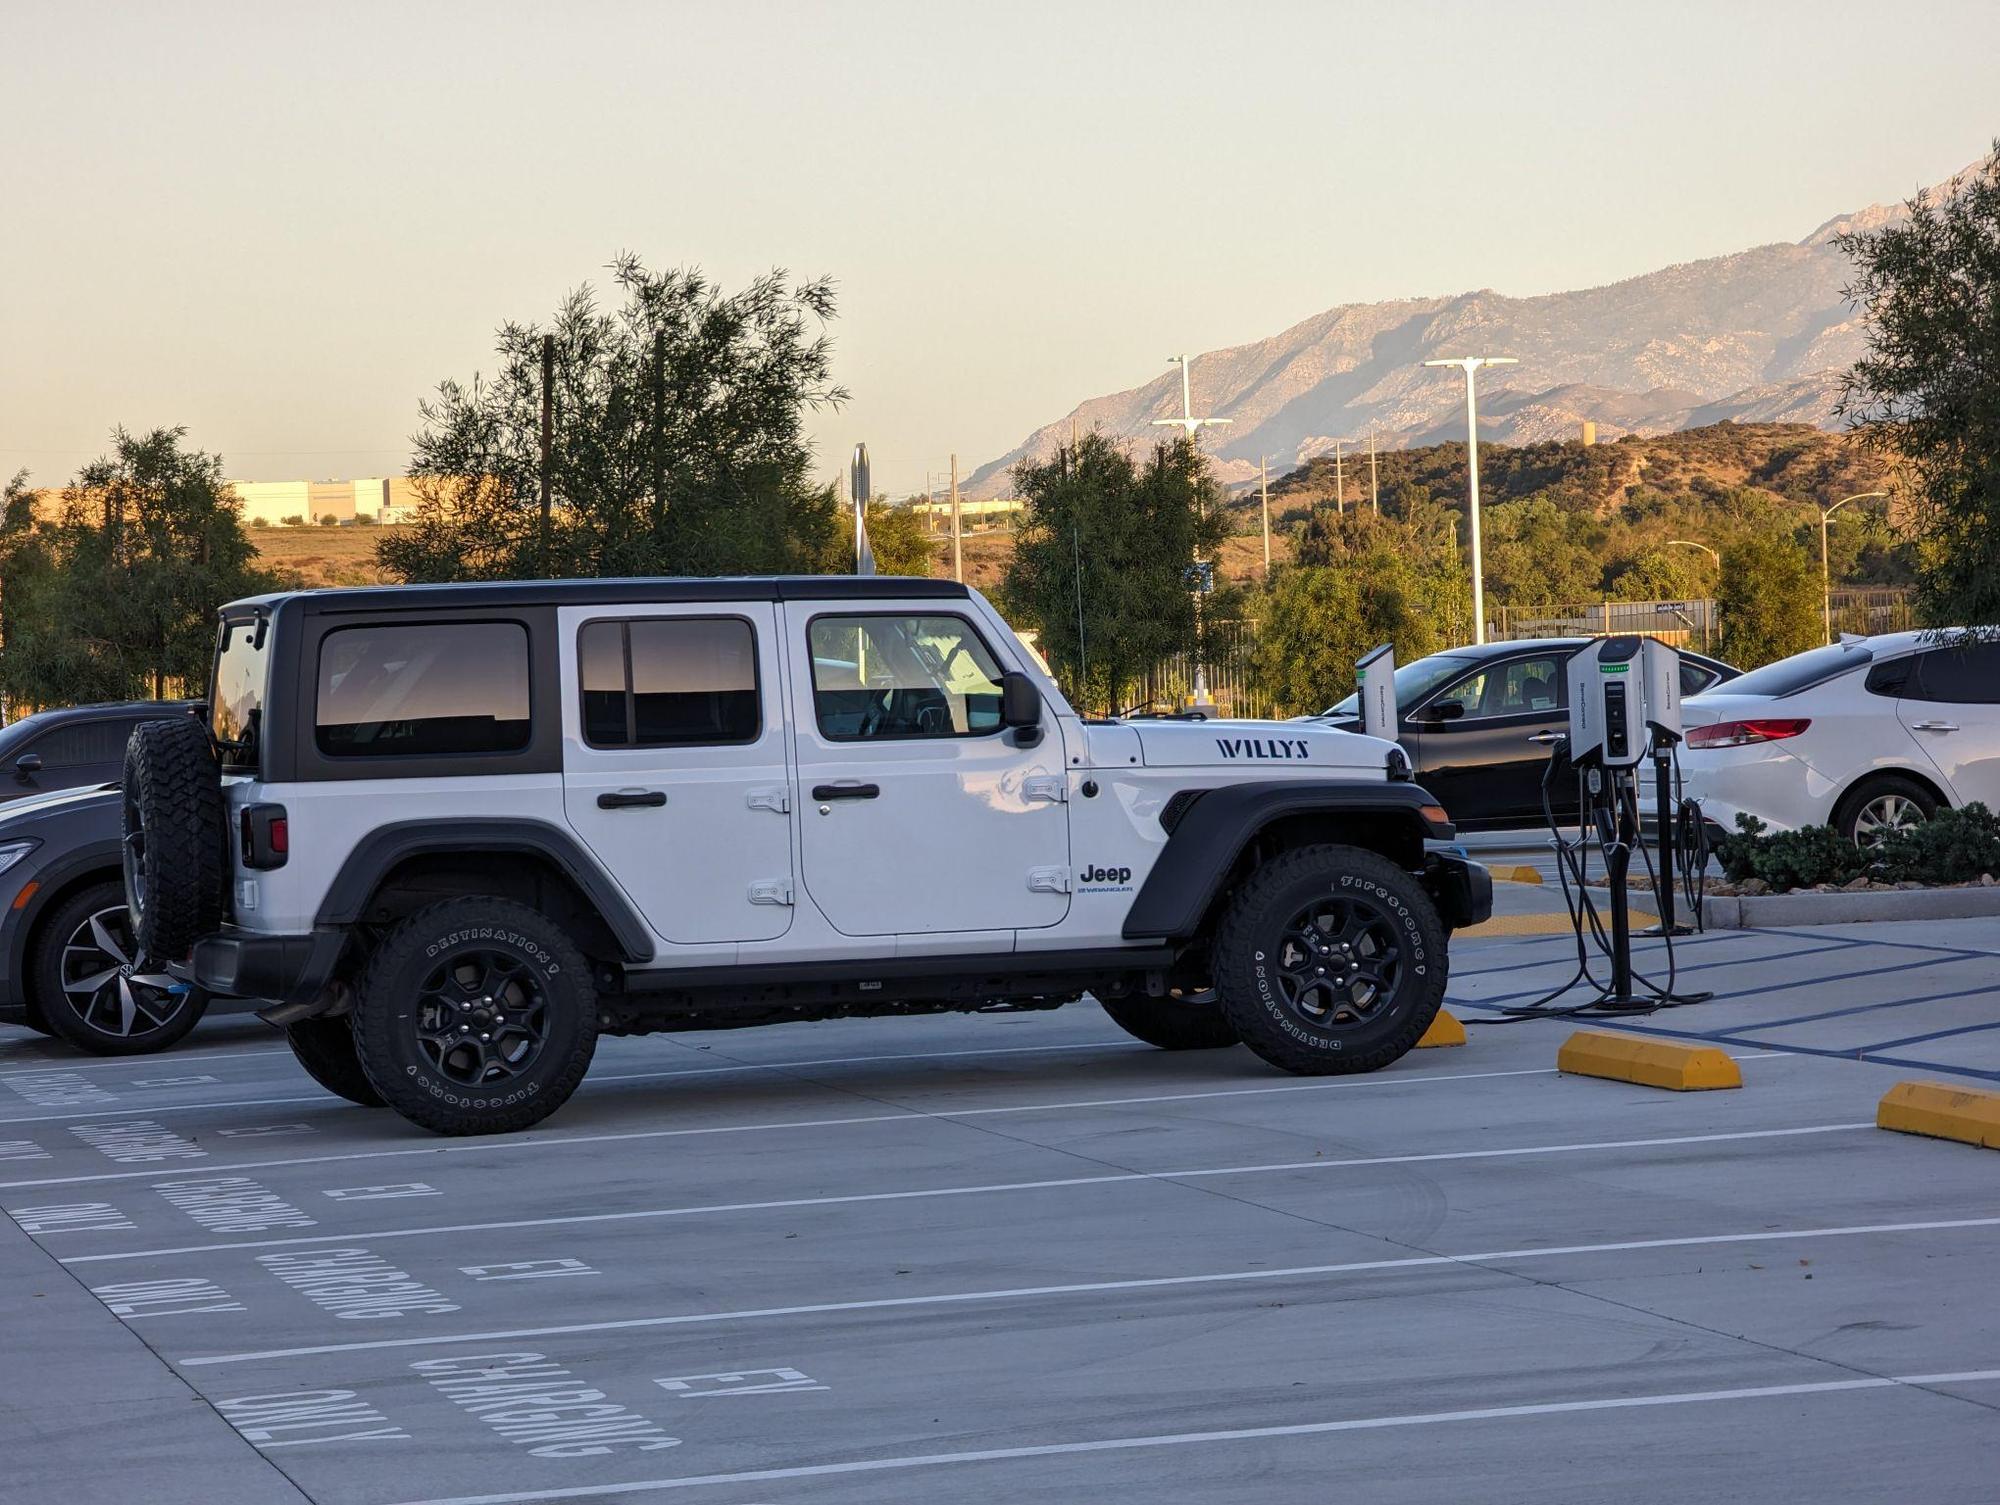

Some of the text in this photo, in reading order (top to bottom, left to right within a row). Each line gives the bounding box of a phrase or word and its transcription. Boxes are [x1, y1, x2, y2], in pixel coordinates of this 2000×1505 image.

[1215, 739, 1309, 759] WILLYS
[1080, 864, 1132, 885] Jeep
[426, 928, 550, 963] DESTINATION
[1256, 966, 1342, 1050] DESTINATION
[151, 1177, 319, 1233] CHARGING
[322, 1182, 444, 1201] EV
[8, 1202, 138, 1235] ONLY
[255, 1248, 462, 1319] CHARGING
[457, 1258, 602, 1281] EV
[90, 1278, 247, 1320] ONLY
[653, 1367, 831, 1398] EV
[213, 1389, 412, 1449] ONLY
[408, 1352, 683, 1458] CHARGING
